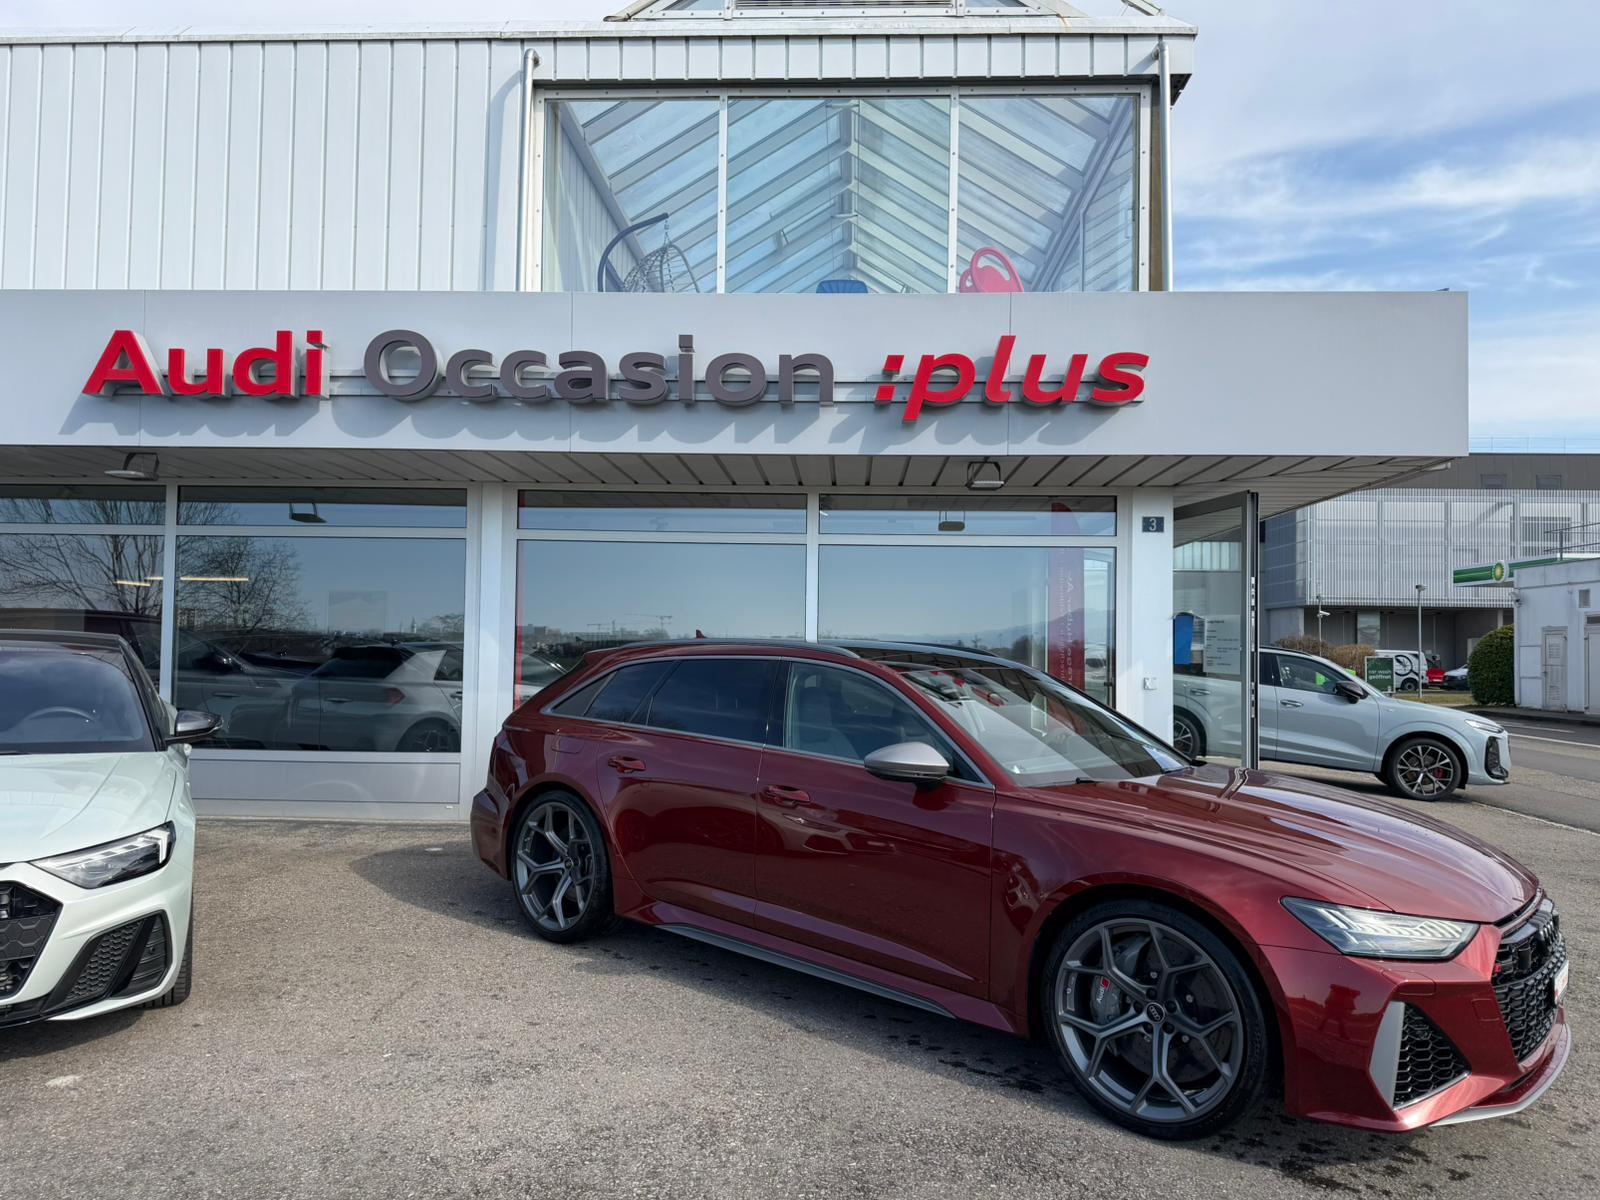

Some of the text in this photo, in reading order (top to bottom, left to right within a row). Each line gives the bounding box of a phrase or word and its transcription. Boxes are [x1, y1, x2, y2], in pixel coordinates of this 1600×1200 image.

[82, 330, 324, 397] Audi
[364, 329, 835, 405] Occasion
[1149, 517, 1157, 531] 3
